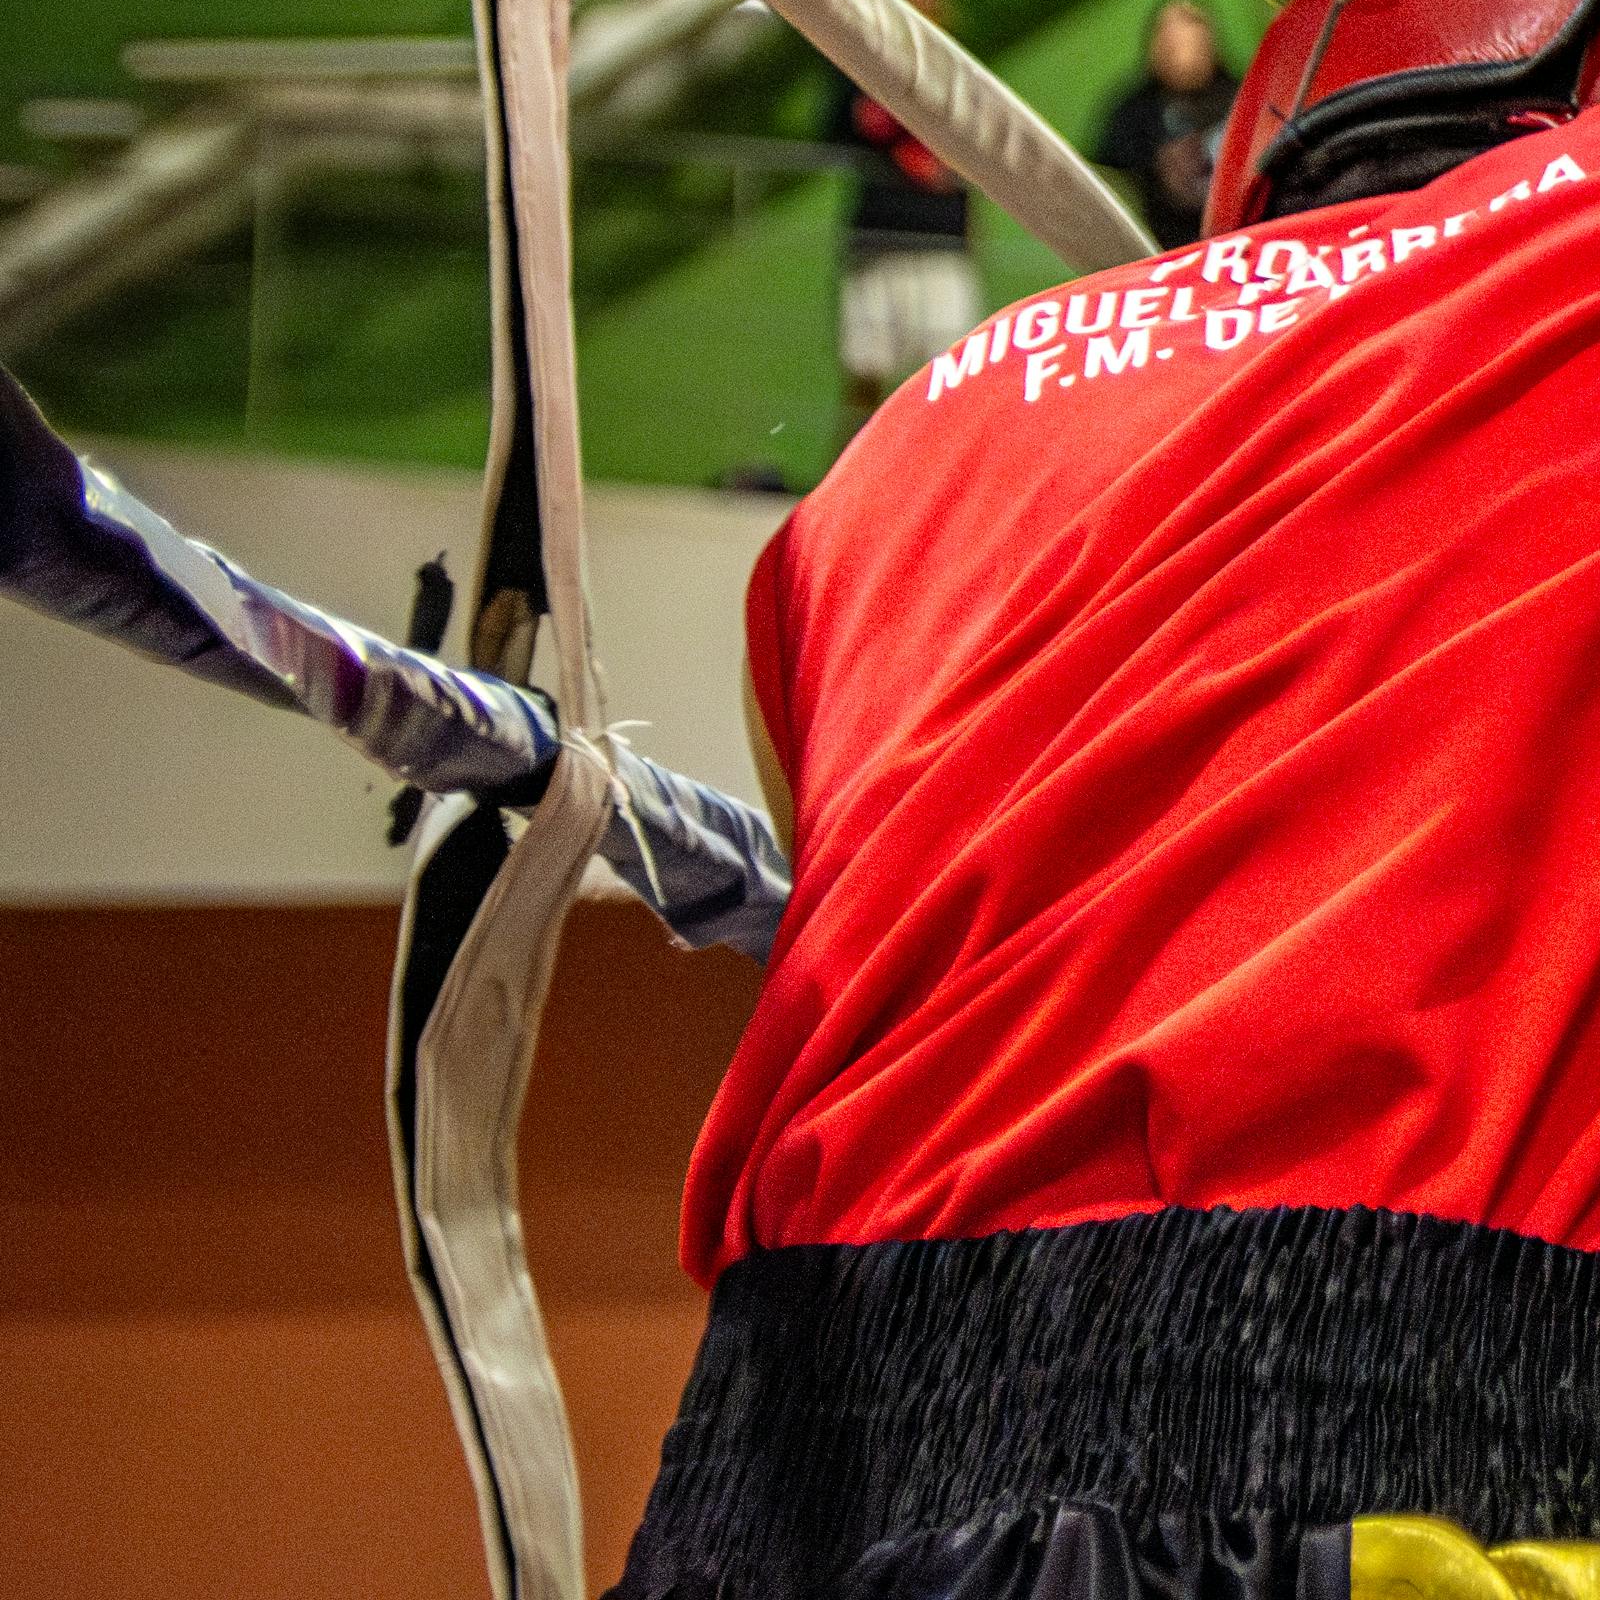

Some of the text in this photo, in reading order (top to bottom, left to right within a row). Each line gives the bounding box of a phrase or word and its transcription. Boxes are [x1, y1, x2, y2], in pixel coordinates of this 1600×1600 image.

[926, 286, 1199, 403] MIGUEL
[1023, 297, 1306, 403] F.M. DE
